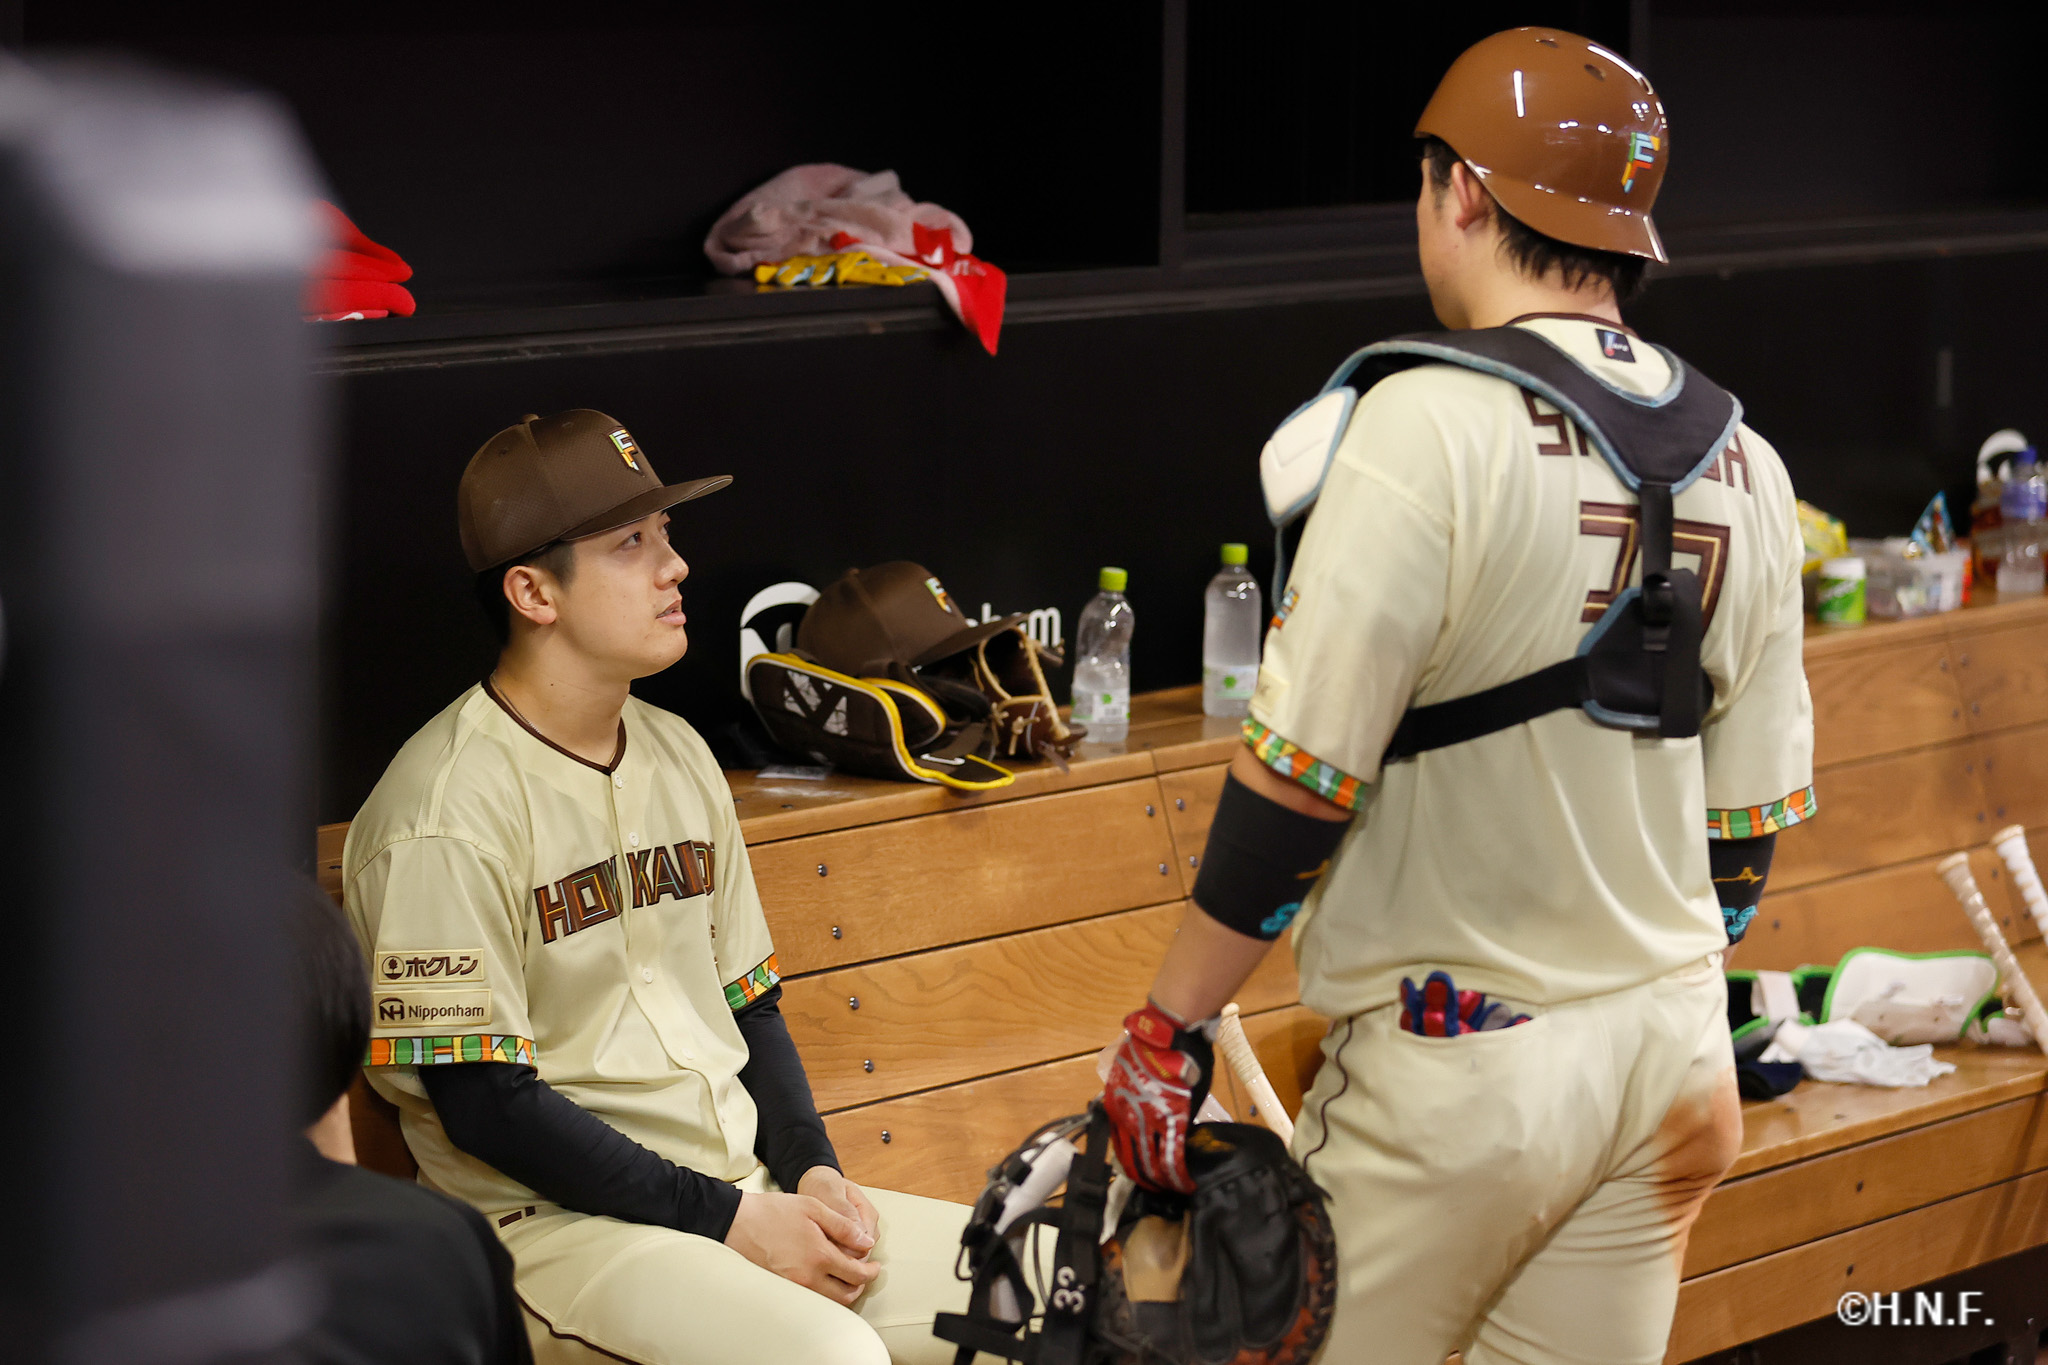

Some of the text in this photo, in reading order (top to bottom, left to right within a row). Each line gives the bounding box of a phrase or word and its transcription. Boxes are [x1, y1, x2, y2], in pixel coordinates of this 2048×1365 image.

[533, 839, 715, 945] HOKKAID
[405, 955, 478, 978] ホクレン
[408, 1004, 484, 1021] Nipponham
